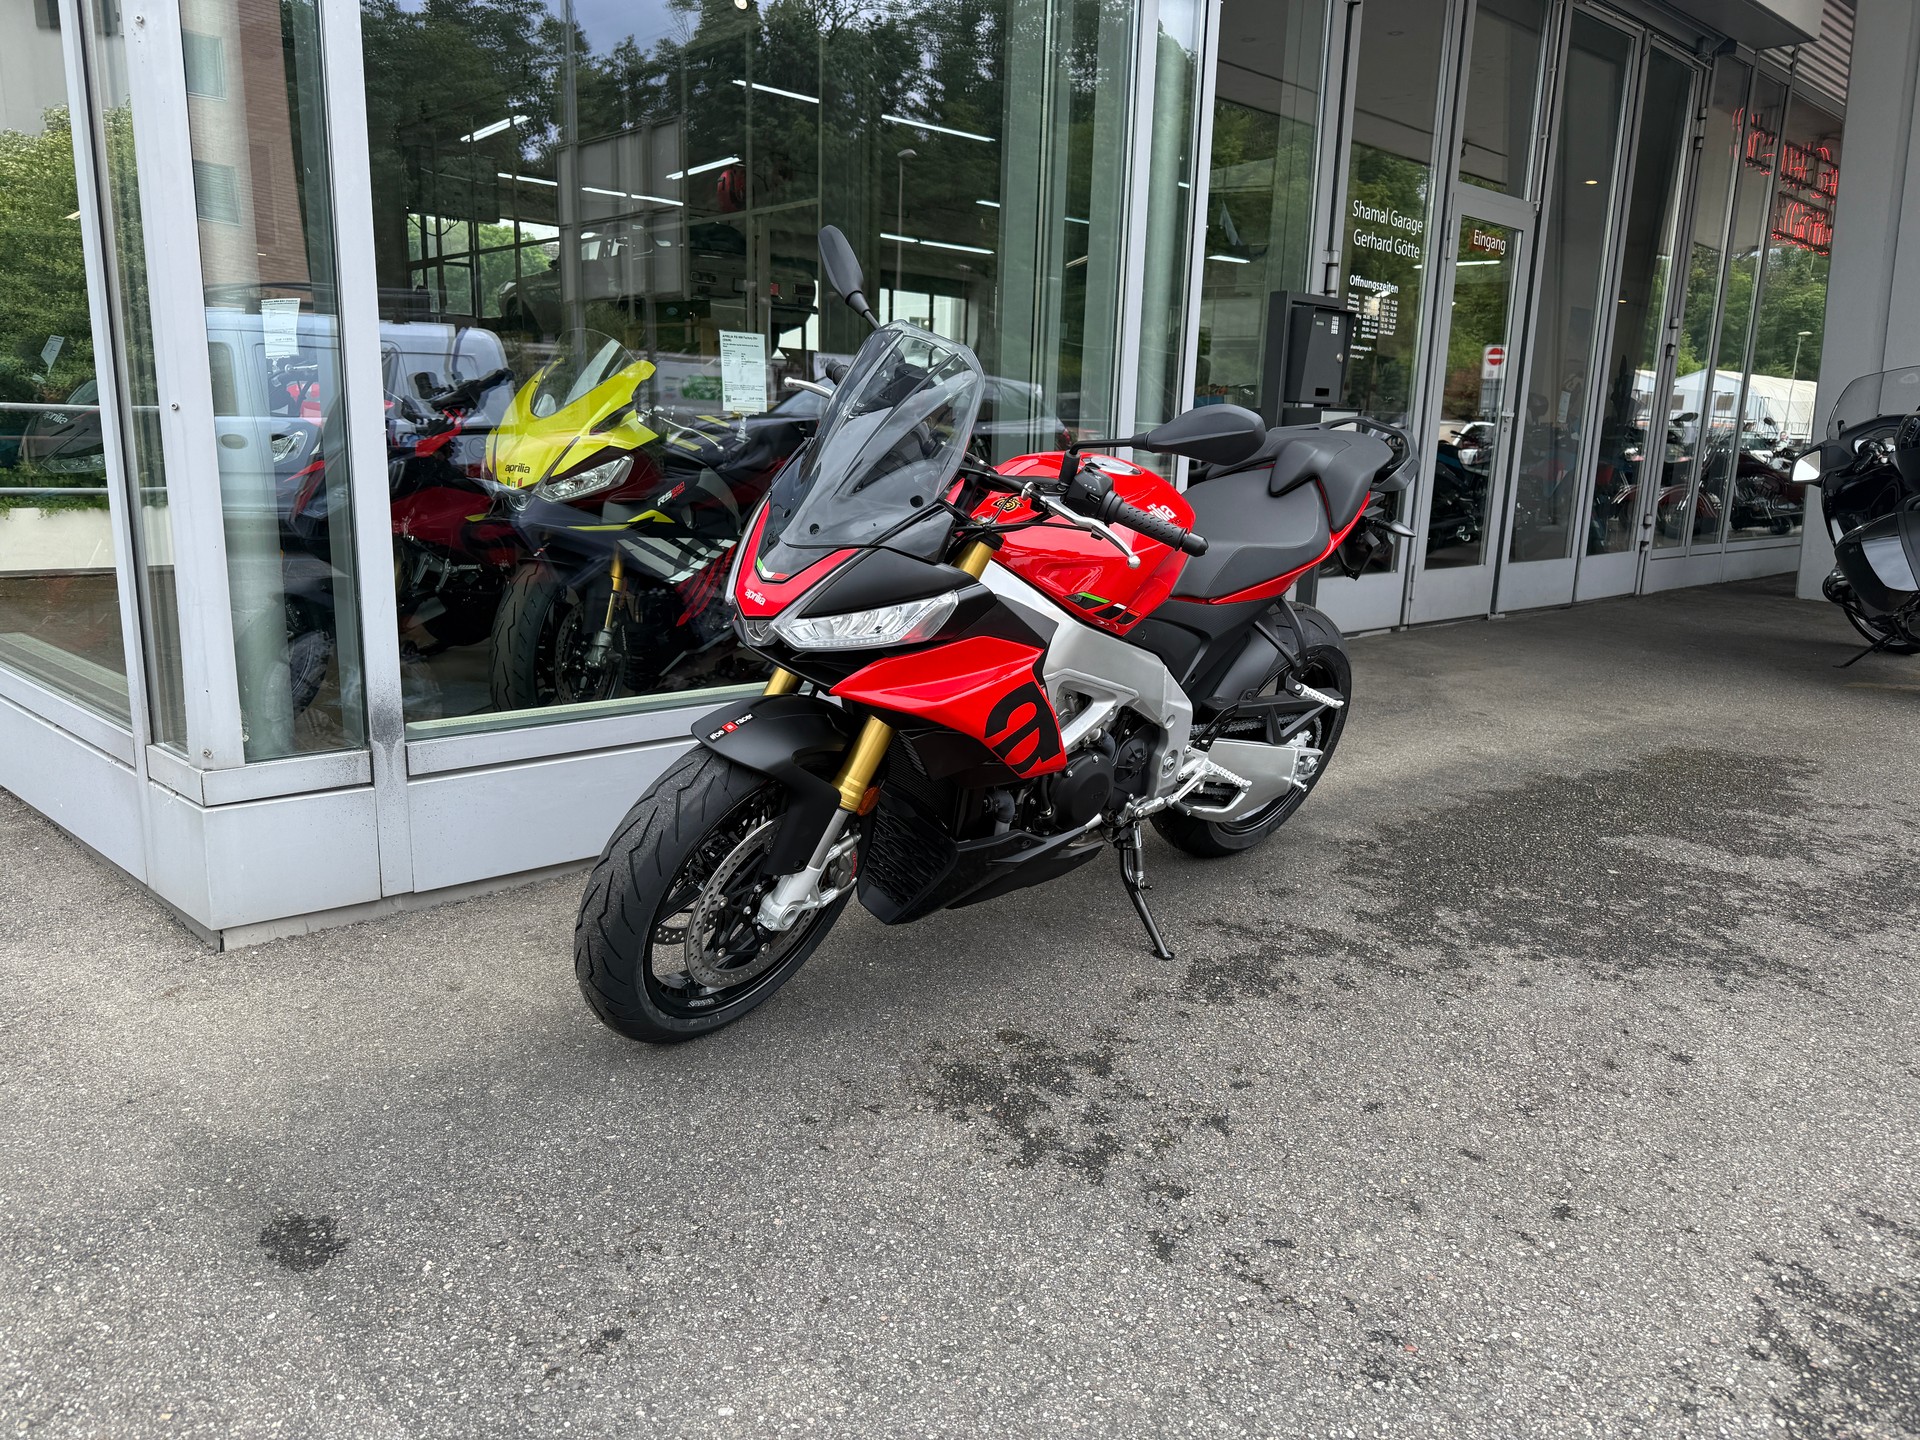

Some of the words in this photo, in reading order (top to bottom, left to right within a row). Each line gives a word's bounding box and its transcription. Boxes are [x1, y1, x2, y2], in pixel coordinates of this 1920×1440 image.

[1352, 199, 1389, 224] Shamal
[1390, 210, 1423, 235] Garage
[1353, 228, 1392, 253] Gerhard
[1394, 239, 1420, 259] Götte
[1473, 229, 1506, 255] Eingang
[505, 462, 531, 474] aprilia
[744, 588, 766, 606] aprilia
